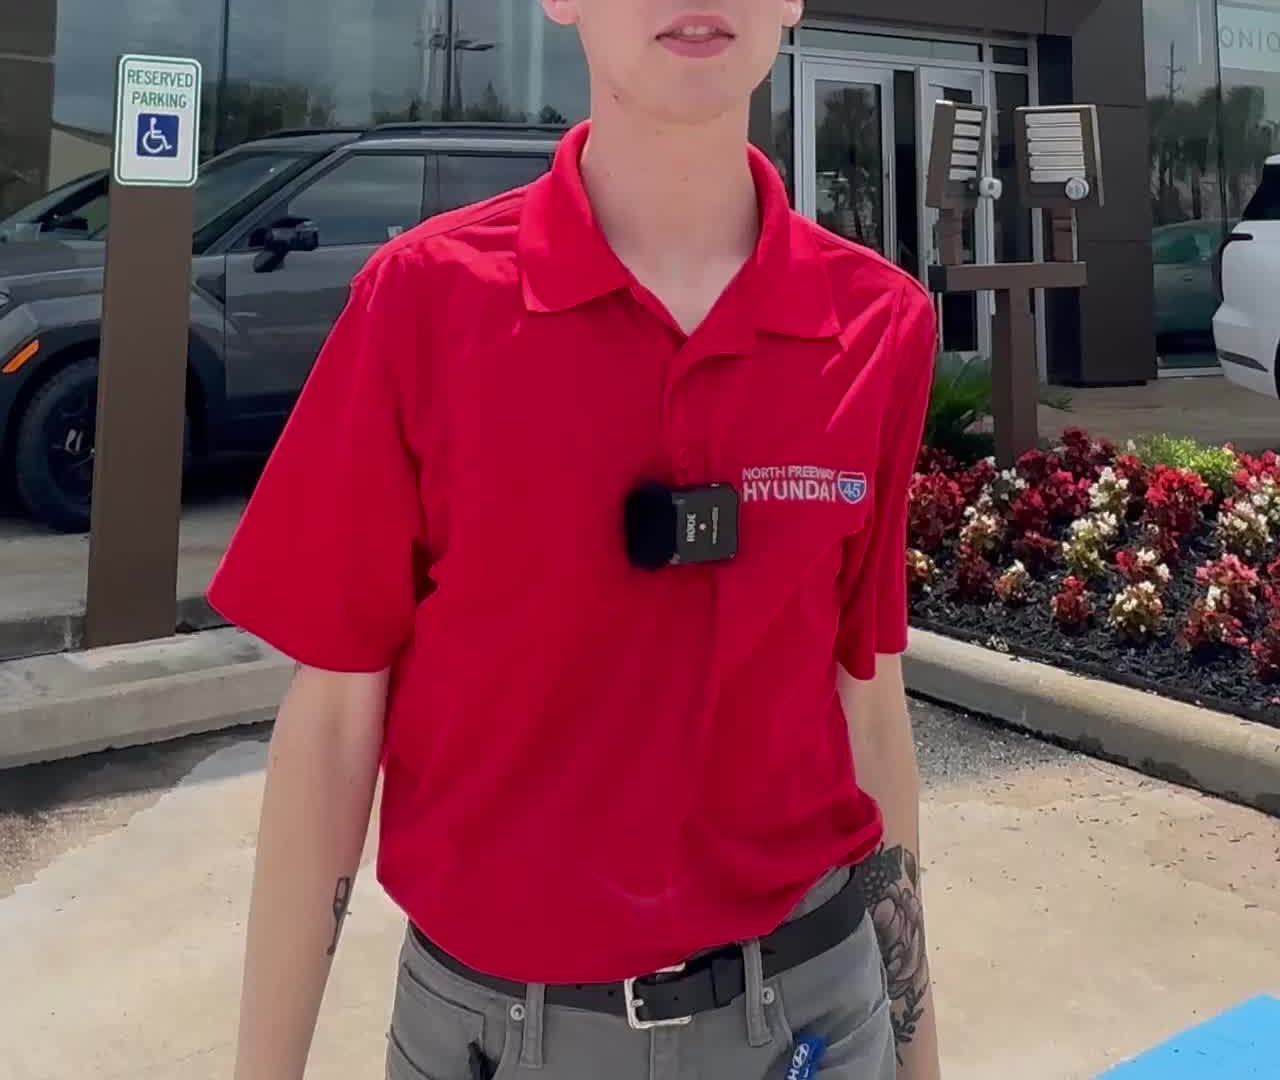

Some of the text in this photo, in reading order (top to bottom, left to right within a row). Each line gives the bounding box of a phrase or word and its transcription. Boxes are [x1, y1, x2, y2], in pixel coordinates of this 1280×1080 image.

[127, 69, 193, 88] RESERVED
[132, 91, 187, 109] PARKING
[742, 465, 837, 480] NORTH FREEWAY
[743, 480, 836, 502] HYUNDAI
[843, 482, 861, 499] 45
